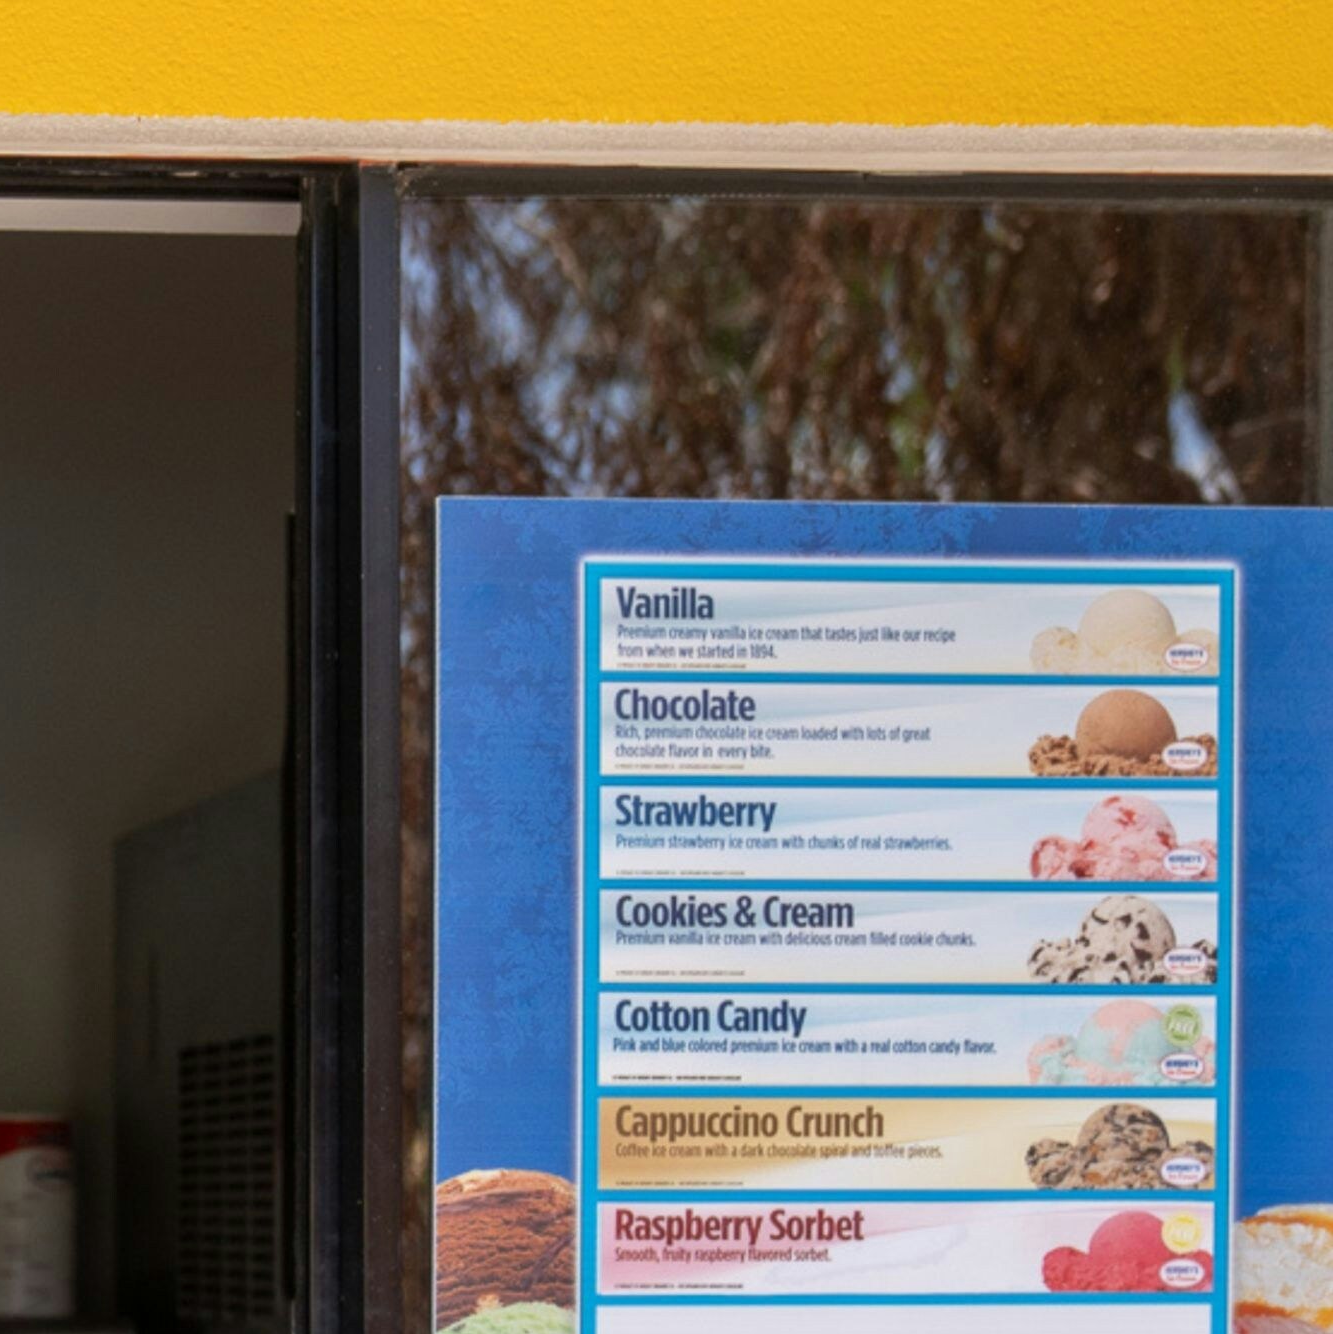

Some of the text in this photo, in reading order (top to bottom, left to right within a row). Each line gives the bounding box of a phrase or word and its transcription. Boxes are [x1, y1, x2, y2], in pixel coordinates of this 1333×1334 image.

[617, 586, 714, 620] Vanilla
[617, 624, 955, 644] Premium creamy vanilla ice cream that tastes just like our recipe
[617, 643, 643, 658] from
[646, 645, 676, 659] when
[678, 648, 694, 659] we
[696, 645, 735, 660] started
[736, 646, 747, 659] in
[615, 688, 755, 721] Chocolate
[642, 727, 694, 742] premium
[695, 725, 747, 741] chocolate
[748, 726, 763, 741] ice
[765, 728, 799, 741] cream
[801, 726, 838, 742] loaded
[840, 728, 865, 741] with
[888, 726, 901, 742] of
[902, 728, 931, 744] great
[615, 744, 666, 759] chocolate
[668, 744, 699, 759] flavor
[701, 746, 713, 759] in
[717, 747, 748, 760] every
[616, 794, 775, 832] Strawberry
[616, 833, 666, 849] Premium
[667, 836, 725, 851] strawberry
[728, 836, 743, 850] ice
[745, 838, 779, 850] cream
[781, 836, 805, 849] with
[808, 836, 845, 850] chunks
[847, 836, 860, 851] of
[861, 836, 881, 851] real
[616, 895, 855, 928] Cookies & Cream
[616, 929, 667, 946] Premium
[667, 931, 704, 946] vanilla
[705, 932, 721, 946] ice
[723, 934, 757, 946] cream
[759, 932, 783, 946] with
[785, 932, 833, 947] delicious
[834, 934, 867, 947] cream
[869, 932, 898, 947] filled
[899, 934, 934, 947] cookie
[616, 1000, 806, 1038] Cotton Candy
[613, 1037, 637, 1053] Pink
[639, 1038, 660, 1053] and
[661, 1038, 686, 1054] blue
[688, 1038, 728, 1054] colored
[729, 1039, 779, 1055] premium
[781, 1037, 797, 1054] ice
[798, 1042, 831, 1054] cream
[834, 1040, 859, 1053] with
[861, 1042, 867, 1054] a
[870, 1039, 891, 1054] real
[893, 1040, 927, 1055] cotton
[929, 1040, 961, 1056] candy
[616, 1105, 884, 1143] Cappuccino Crunch
[616, 1143, 650, 1159] Coffee
[651, 1142, 667, 1159] ice
[669, 1142, 702, 1159] cream
[705, 1144, 729, 1158] with
[731, 1146, 739, 1159] a
[739, 1144, 764, 1159] dark
[766, 1144, 818, 1159] chocolate
[850, 1144, 873, 1159] and
[616, 1209, 863, 1246] Raspberry Sorbet
[661, 1246, 691, 1264] fruity
[693, 1248, 746, 1264] raspberry
[747, 1246, 793, 1263] flavored
